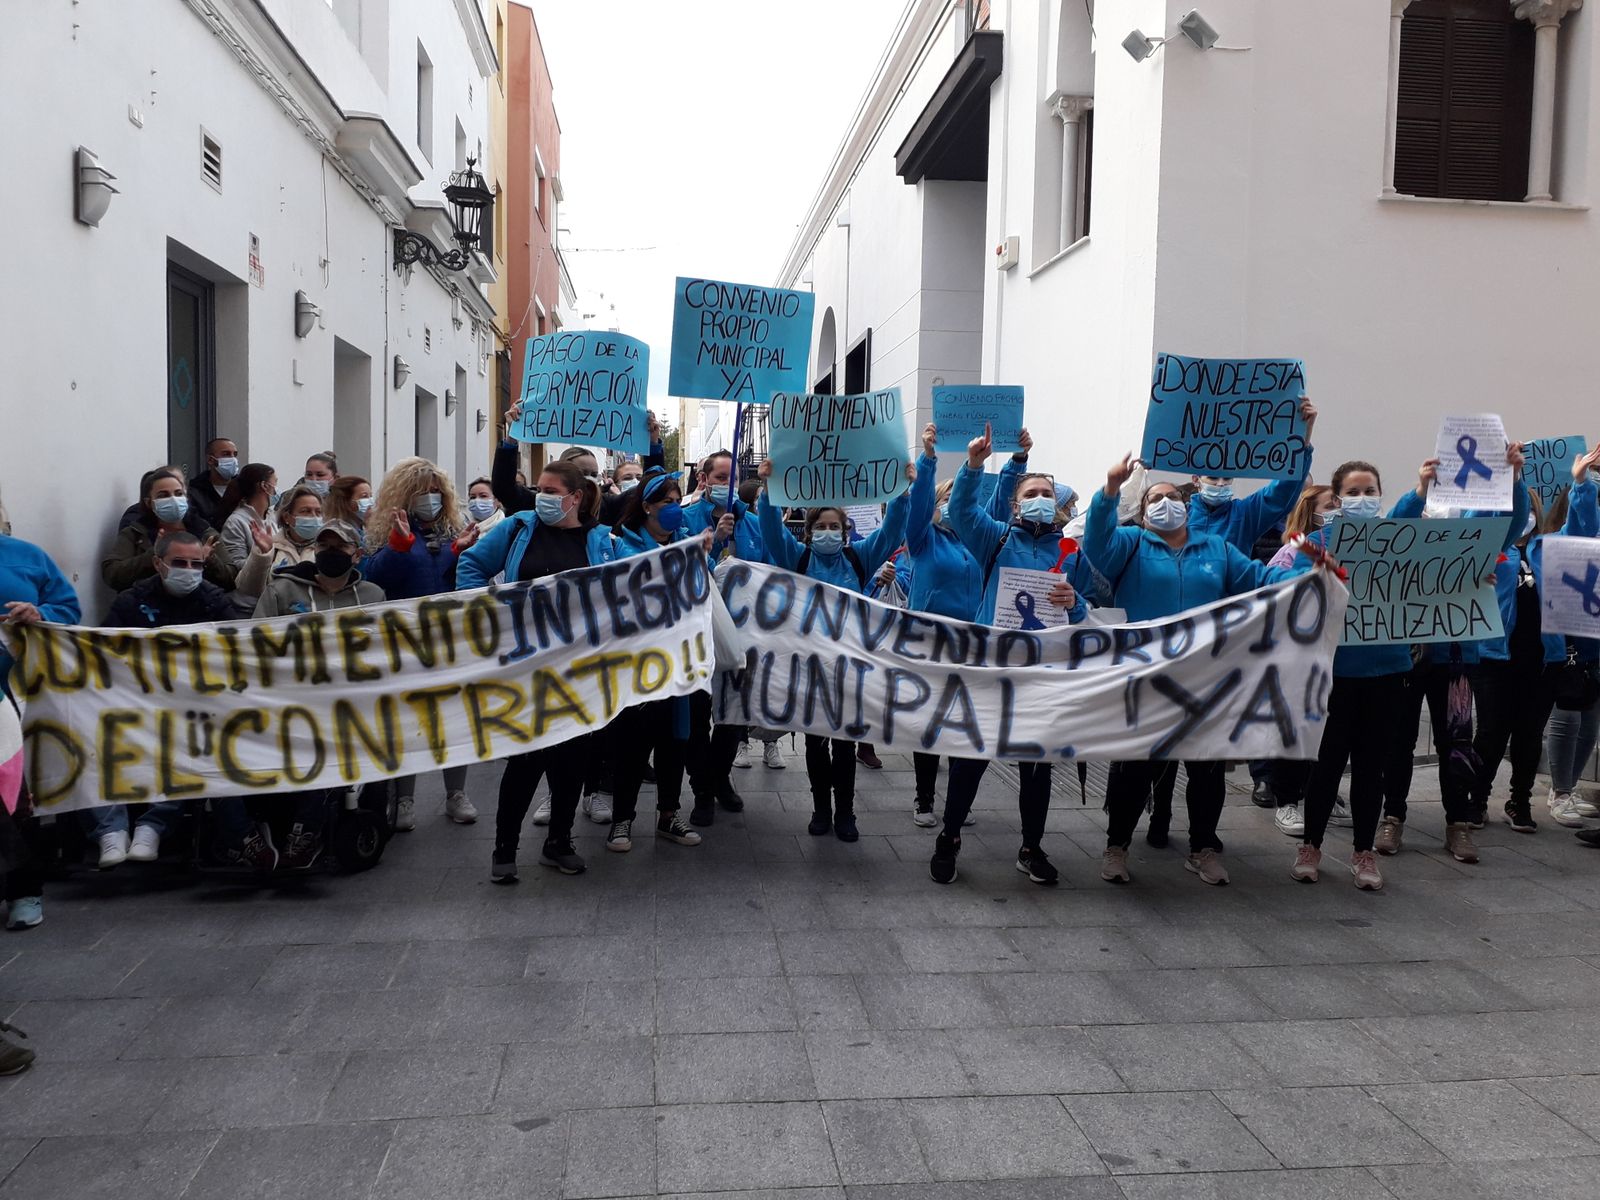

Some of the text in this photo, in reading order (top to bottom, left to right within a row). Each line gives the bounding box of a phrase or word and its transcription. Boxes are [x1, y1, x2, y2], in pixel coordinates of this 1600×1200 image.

[685, 279, 799, 318] CONVENIO
[699, 310, 769, 343] PROPIO
[530, 335, 640, 369] PAGO DE LA
[697, 341, 792, 370] MUNICIPAL
[524, 365, 642, 406] FORMACIÓN
[720, 369, 755, 400] YA
[523, 408, 634, 447] REALIZADA
[769, 391, 895, 432] CUMPLIMIENTO
[1181, 400, 1297, 439] NUESTRA
[808, 434, 849, 463] DEL
[1152, 435, 1305, 475] PSICÓLOG@?
[783, 457, 899, 501] CONTRATO
[1335, 522, 1482, 557] PAGO DE LA
[721, 564, 1327, 670] CONVENIO PROPIO
[1344, 599, 1492, 642] REALIZADA
[9, 595, 500, 702] CUMPLIMIENTO
